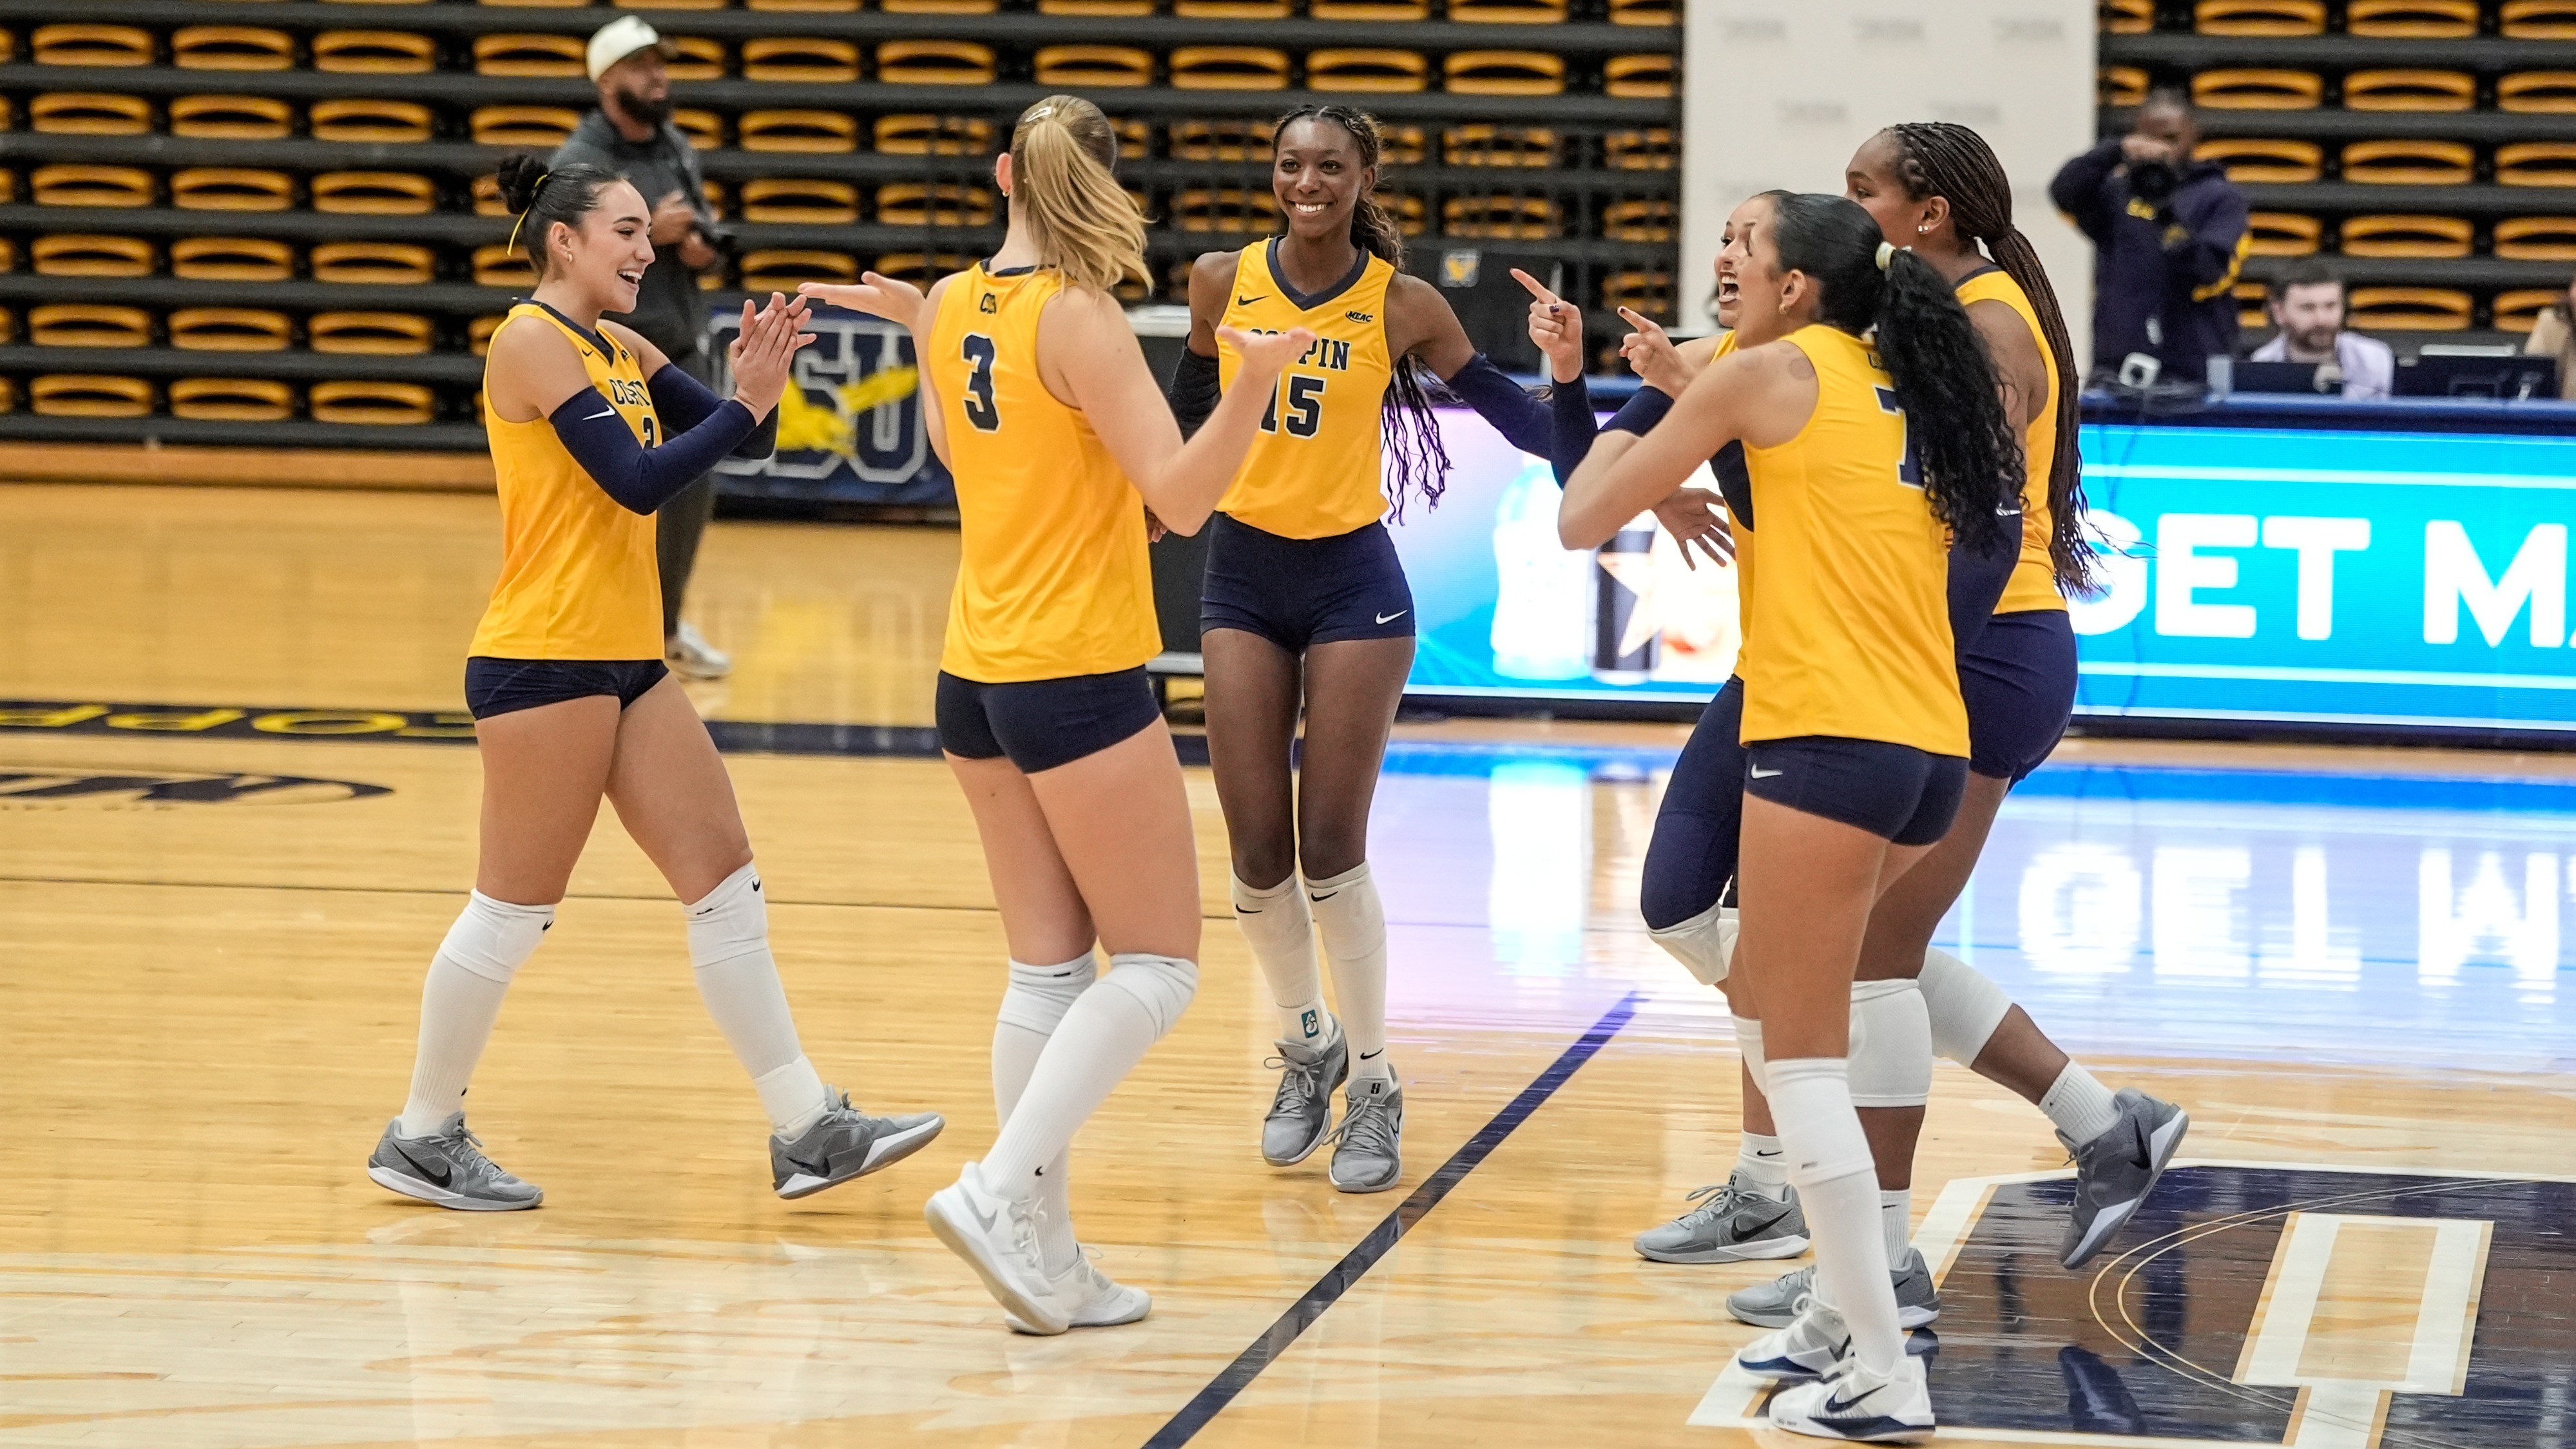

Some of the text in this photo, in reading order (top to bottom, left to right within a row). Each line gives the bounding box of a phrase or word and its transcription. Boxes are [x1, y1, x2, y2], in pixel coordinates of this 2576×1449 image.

[1346, 311, 1374, 323] MEAC
[1250, 329, 1350, 371] PIN
[961, 332, 1002, 434] 3
[642, 416, 655, 449] 2
[2065, 508, 2576, 648] GET M
